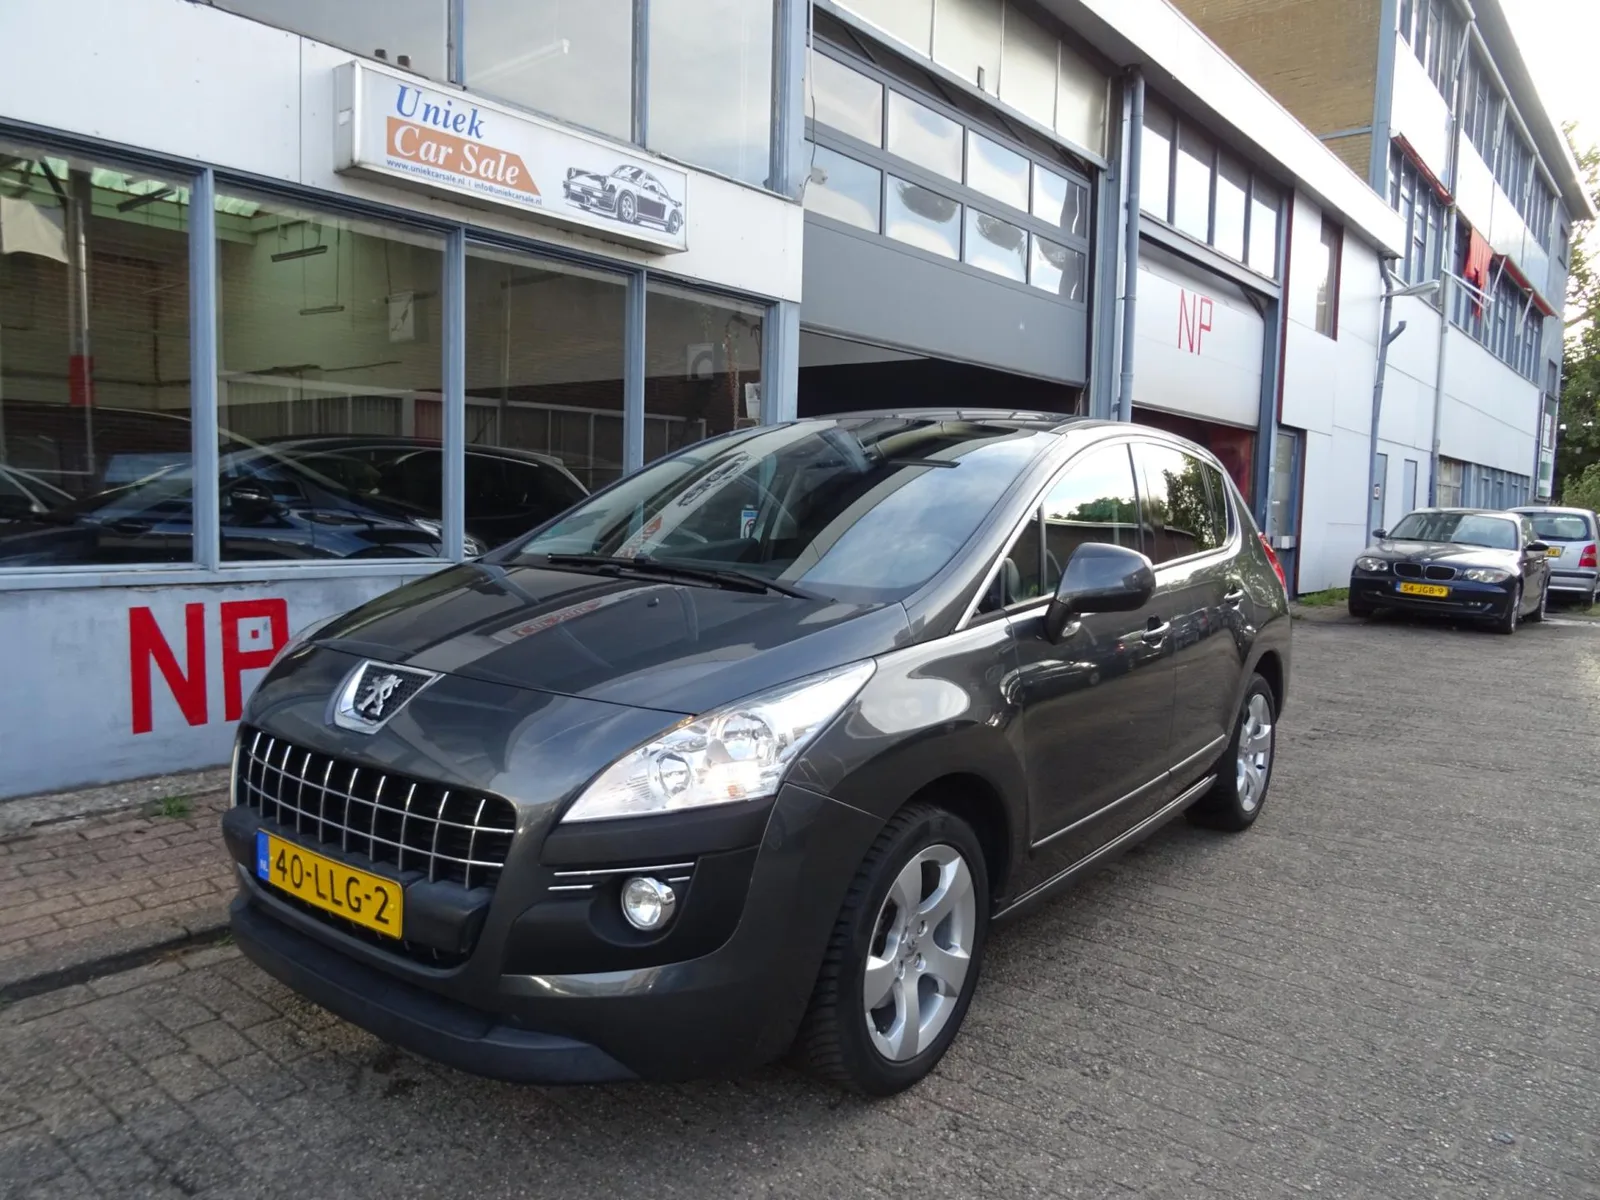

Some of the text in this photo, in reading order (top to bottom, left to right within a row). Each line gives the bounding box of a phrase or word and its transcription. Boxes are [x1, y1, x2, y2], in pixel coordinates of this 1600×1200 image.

[396, 83, 486, 139] Uniek
[386, 158, 466, 185] www.uniekcarsale.nl
[474, 182, 543, 206] info@uniekcarsale.nl
[393, 124, 521, 186] Car Sale
[1178, 288, 1213, 356] NP
[1403, 583, 1445, 595] 54-JGB-9
[129, 598, 289, 735] NP
[276, 848, 390, 925] 40-LLG-2
